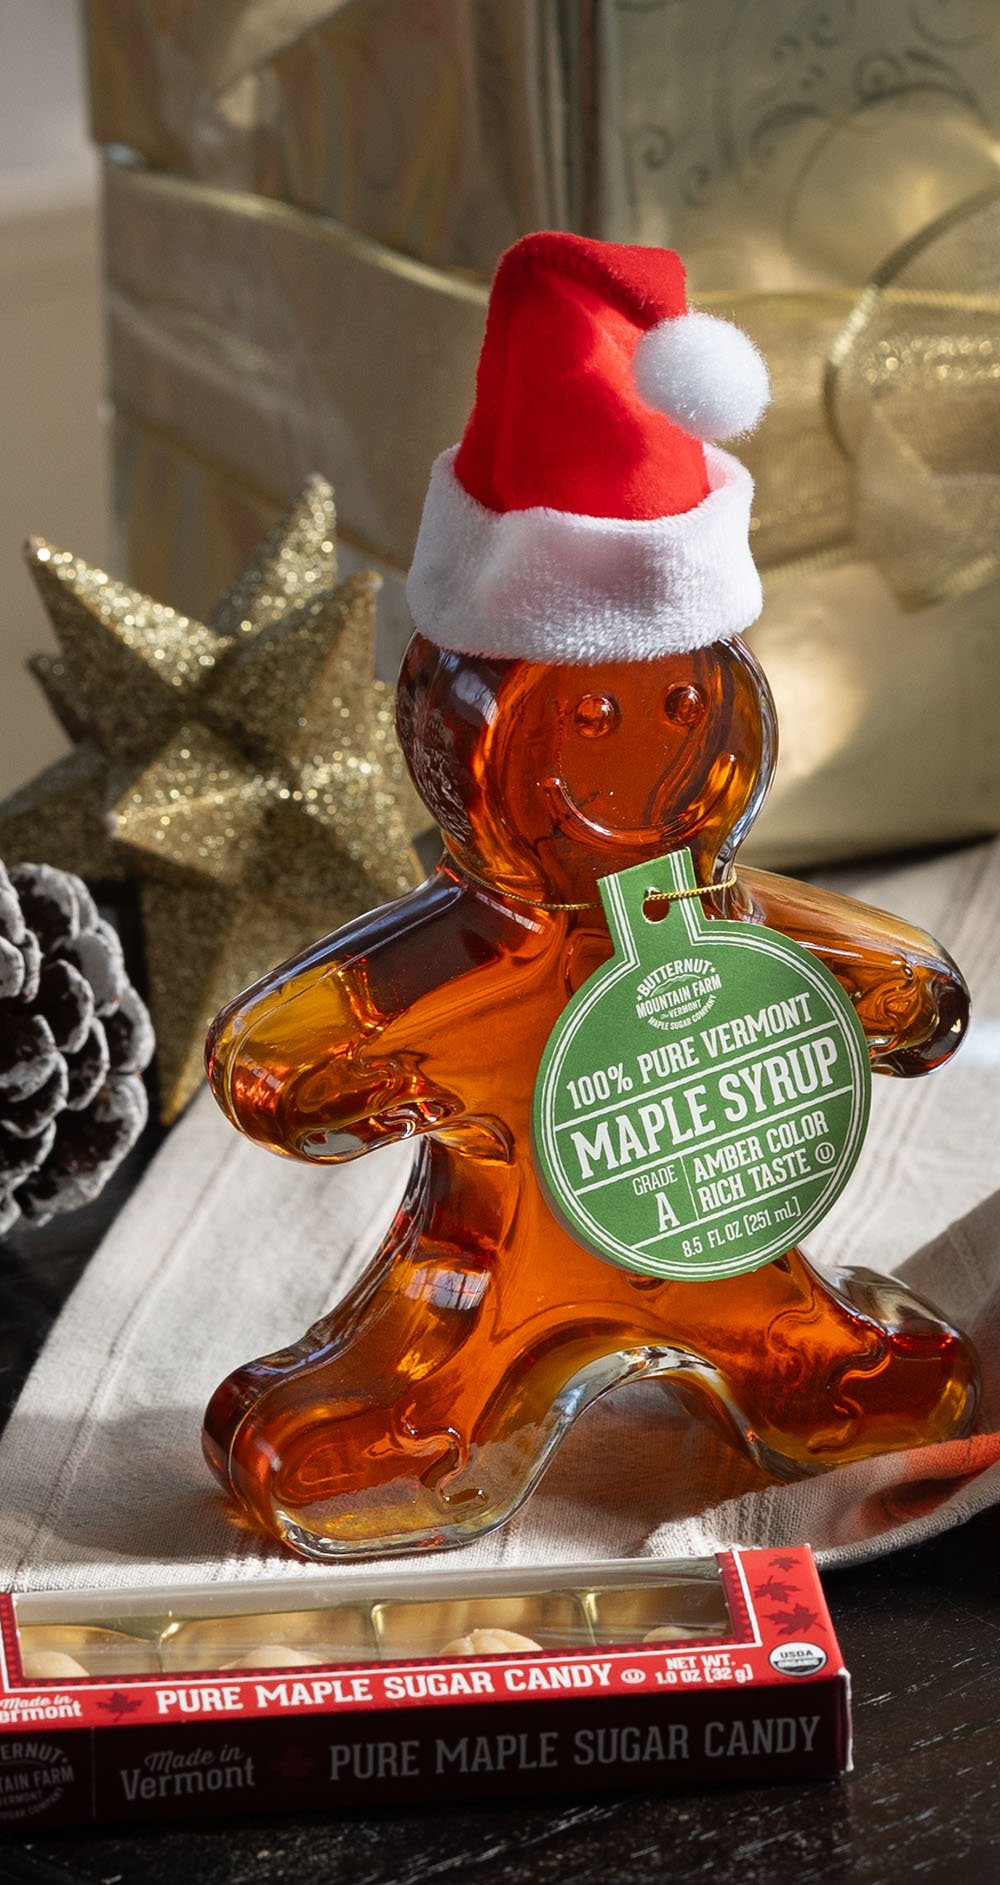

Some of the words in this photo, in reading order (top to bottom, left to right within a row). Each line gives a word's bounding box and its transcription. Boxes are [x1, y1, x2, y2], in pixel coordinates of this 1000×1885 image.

[636, 958, 713, 997] BUTTERNUT
[635, 985, 692, 1019] MOUNTAIN
[691, 974, 722, 998] FARM
[647, 1016, 669, 1030] MAPLE
[670, 1017, 692, 1030] SUGAR
[691, 994, 717, 1023] COMPANY
[668, 999, 702, 1018] VERMONT
[565, 1062, 634, 1110] 100%
[636, 1036, 700, 1084] PURE
[699, 992, 814, 1059] VERMONT
[570, 1084, 717, 1180] MAPLE
[718, 1036, 839, 1122] SYRUP
[693, 1135, 764, 1184] AMBER
[766, 1110, 830, 1153] COLOR
[632, 1164, 678, 1197] GRADE
[697, 1173, 747, 1213] RICH
[747, 1148, 811, 1192] TASTE
[655, 1191, 681, 1232] A
[681, 1235, 703, 1258] 8.5
[706, 1229, 726, 1248] FL
[724, 1221, 743, 1240] OZ
[665, 1656, 697, 1671] NET
[700, 1653, 736, 1667] WT.
[780, 1649, 813, 1658] USDA
[155, 1686, 243, 1714] PURE
[255, 1678, 373, 1708] MAPLE
[383, 1670, 495, 1699] SUGAR
[503, 1663, 613, 1692] CANDY
[655, 1670, 678, 1685] 1.0
[680, 1669, 702, 1683] OZ
[0, 1700, 83, 1723] ermont
[53, 1693, 73, 1706] in
[144, 1747, 214, 1773] Made
[219, 1745, 244, 1761] in
[329, 1740, 421, 1782] PURE
[435, 1731, 559, 1774] MAPLE
[573, 1723, 690, 1766] SUGAR
[704, 1715, 821, 1758] CANDY
[33, 1764, 76, 1789] FARM
[120, 1757, 256, 1802] Vermont
